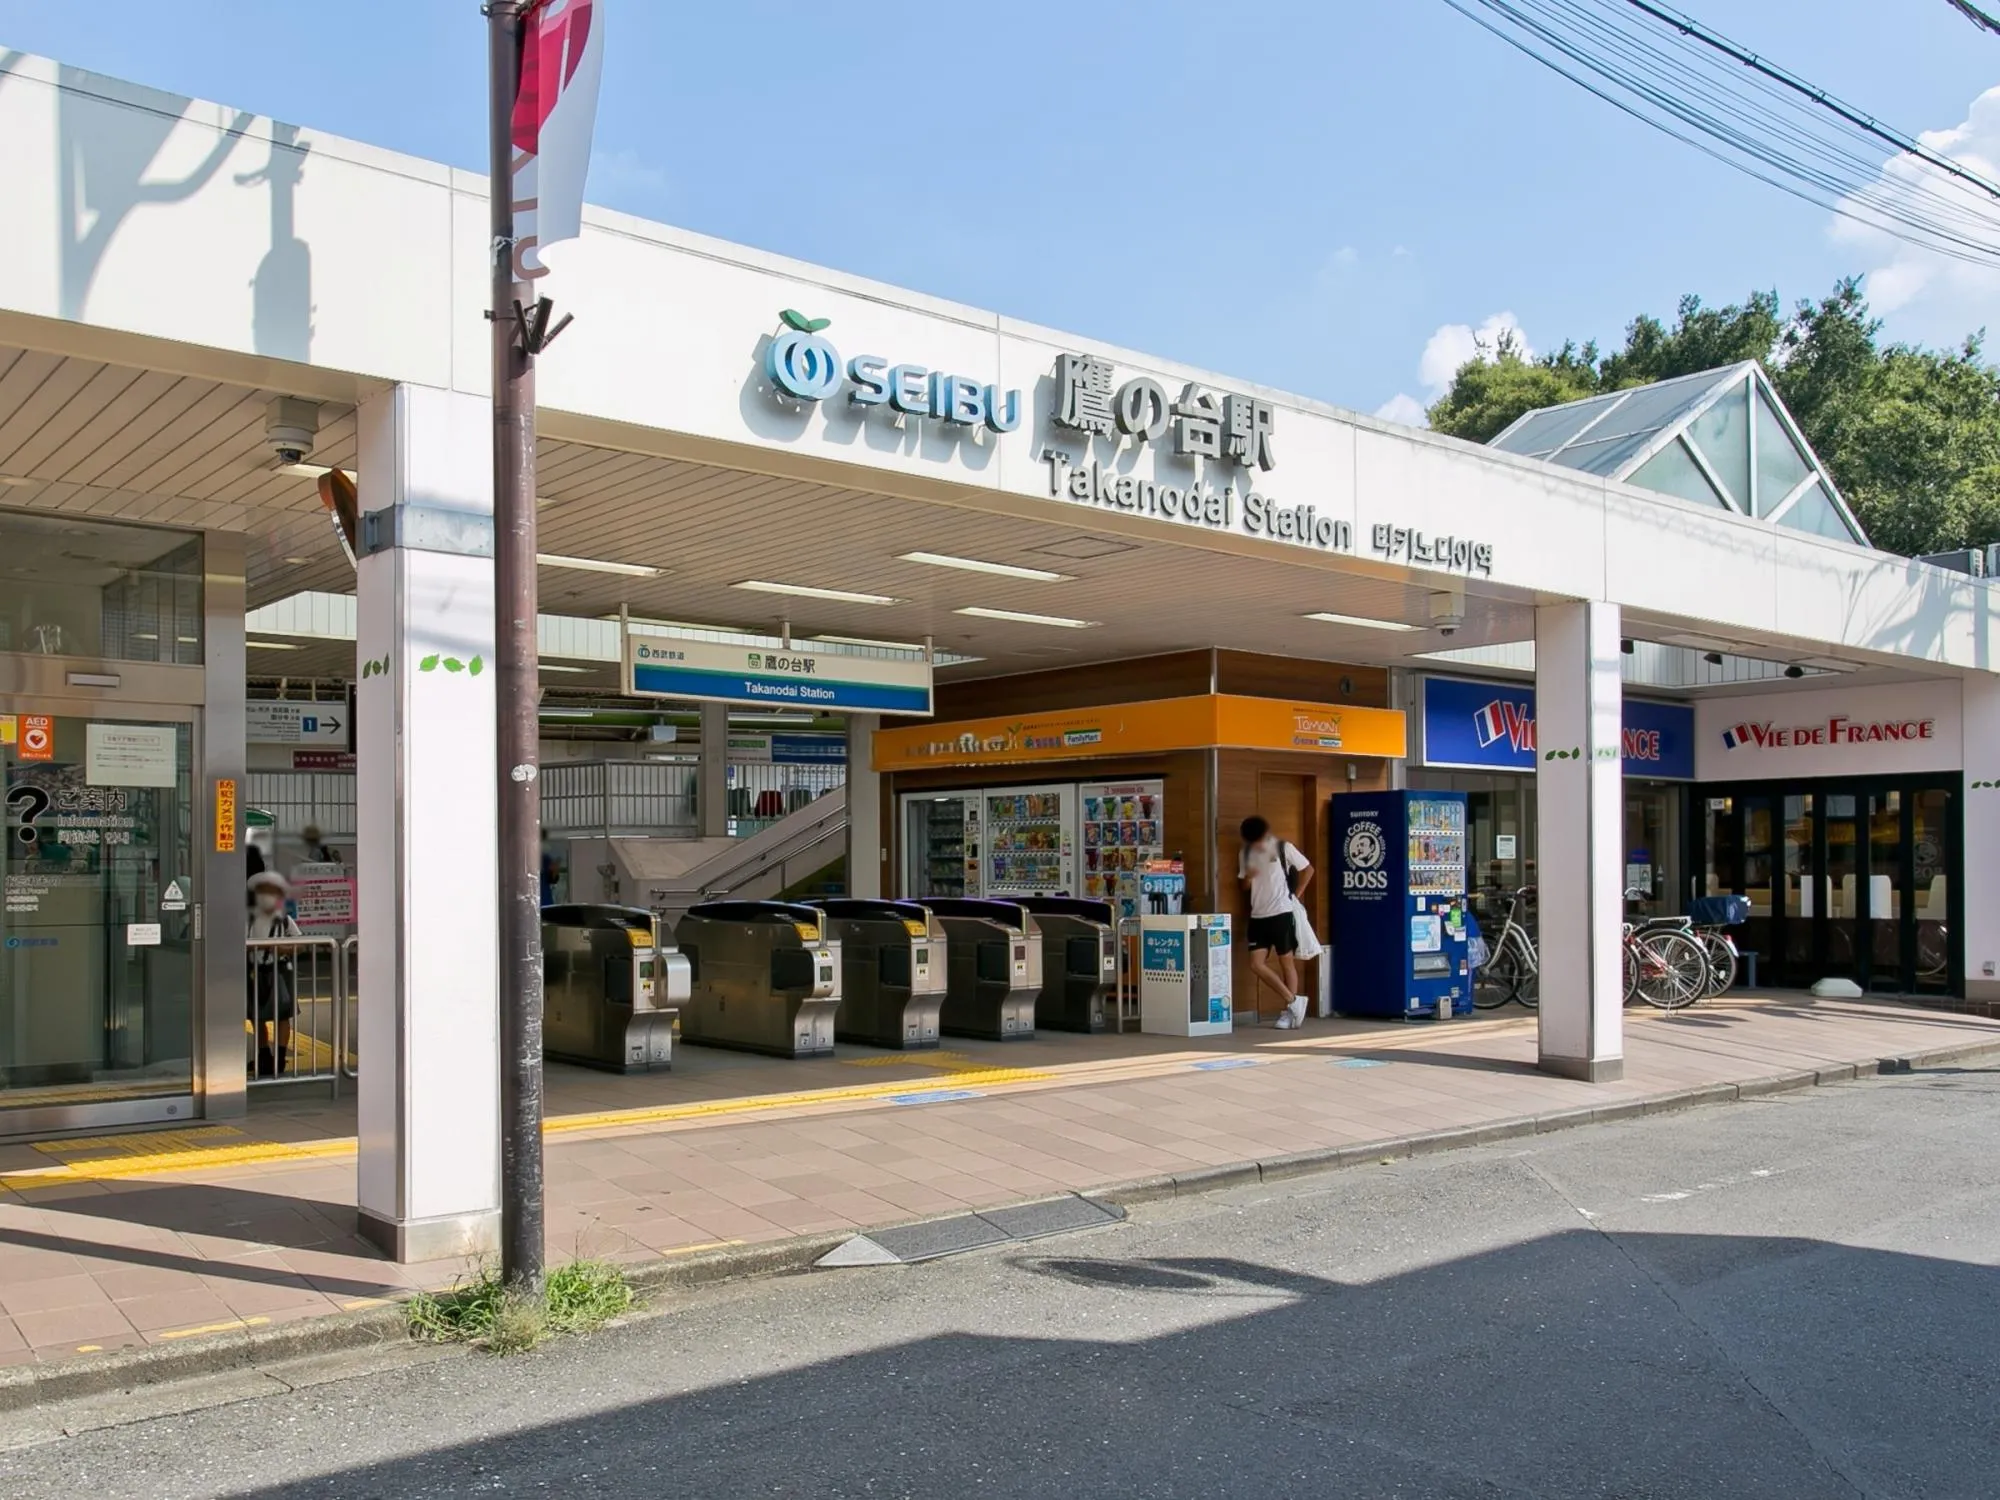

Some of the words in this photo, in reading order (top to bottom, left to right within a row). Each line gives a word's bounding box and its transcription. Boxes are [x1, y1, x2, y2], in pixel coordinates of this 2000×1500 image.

[847, 354, 1021, 434] SEIBU
[1052, 353, 1276, 472] 鷹の台駅
[1043, 449, 1235, 525] Takanodai
[1243, 492, 1353, 549] Station
[765, 655, 815, 673] 鷹の台駅
[744, 682, 797, 697] Takanodai
[800, 686, 835, 700] Station
[26, 717, 48, 726] AED
[1829, 717, 1934, 744] FRANCE
[58, 787, 128, 811] ご案内
[57, 814, 135, 828] Information
[220, 781, 233, 849] 防犯カメラ作動中
[1347, 821, 1382, 836] COFFEE
[1343, 870, 1387, 889] BOSS
